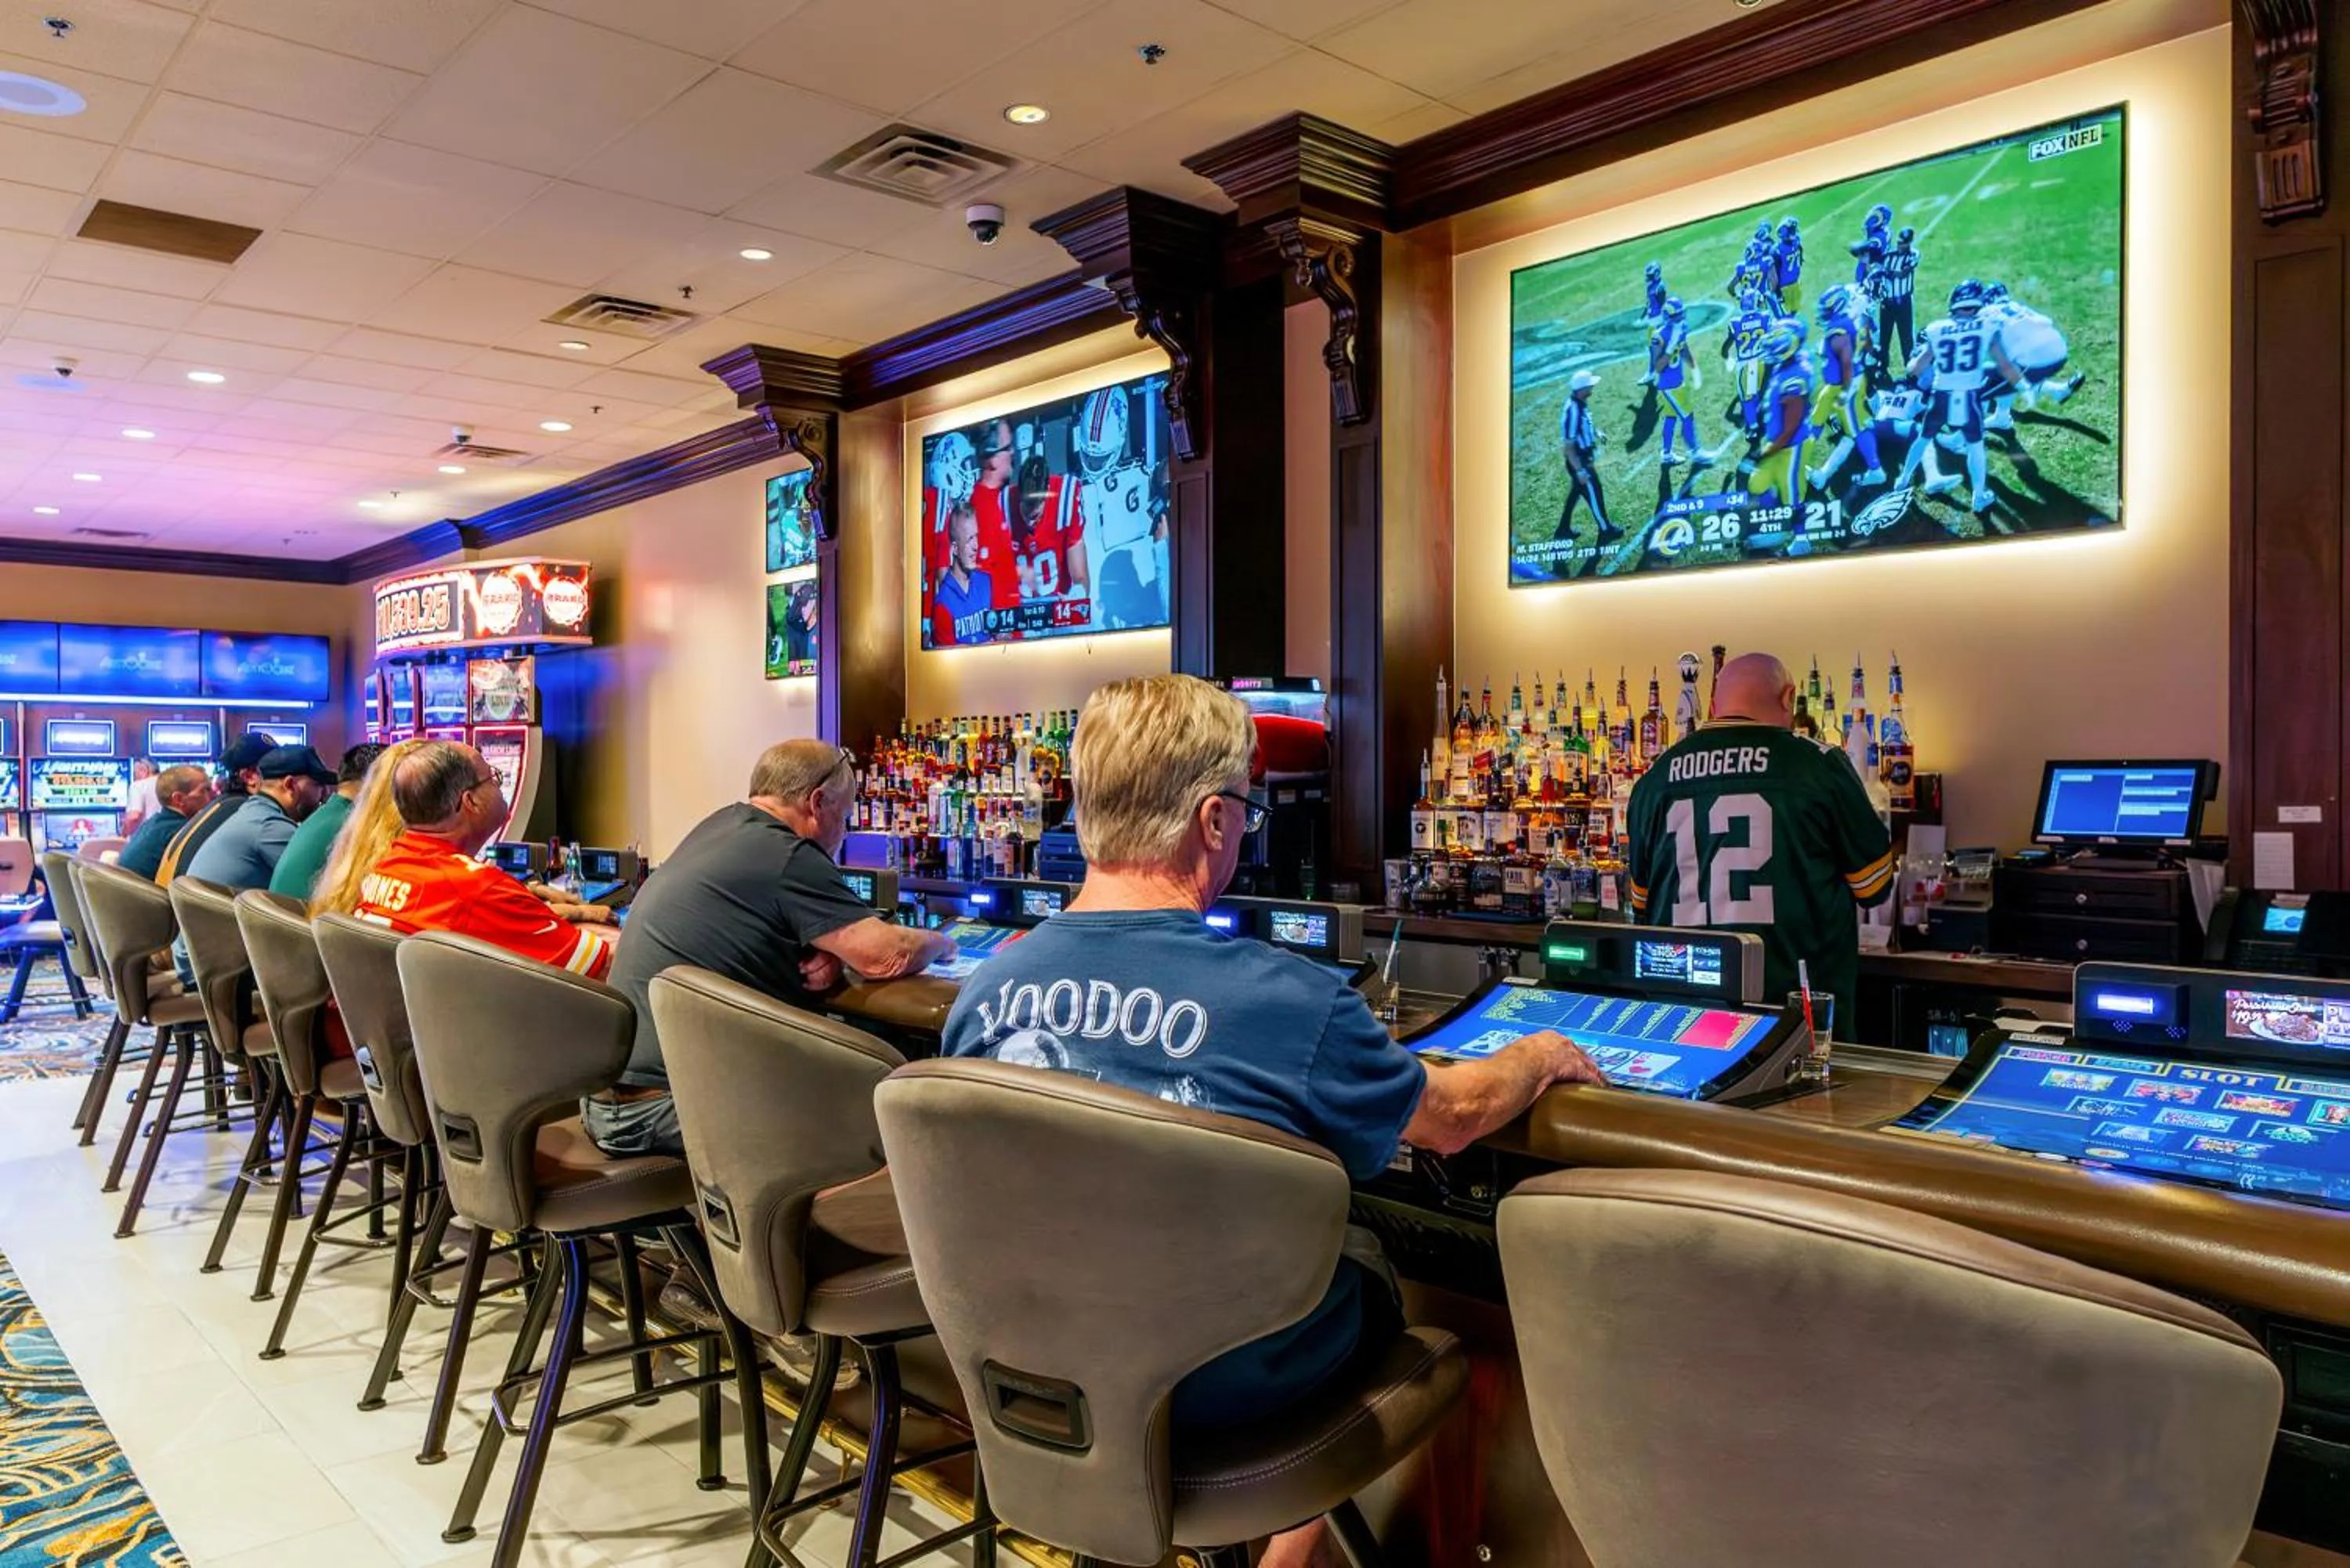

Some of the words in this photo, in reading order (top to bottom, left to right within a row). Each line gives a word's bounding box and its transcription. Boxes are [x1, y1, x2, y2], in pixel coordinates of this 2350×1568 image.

[2030, 135, 2065, 160] FOX
[2068, 128, 2099, 150] NFL
[1937, 335, 1981, 374] 33
[1701, 512, 1741, 542] 26
[1749, 506, 1793, 524] 11:29
[1759, 522, 1782, 533] 4TH
[1804, 499, 1842, 530] 21
[1528, 539, 1574, 552] STAFFORD
[955, 608, 989, 639] PATRIOT
[1000, 610, 1014, 626] 14
[1055, 603, 1072, 620] 14
[1668, 746, 1770, 782] RODGERS
[1666, 793, 1775, 927] 12
[977, 978, 1208, 1058] VOODOO
[2179, 1068, 2263, 1087] SLOT
